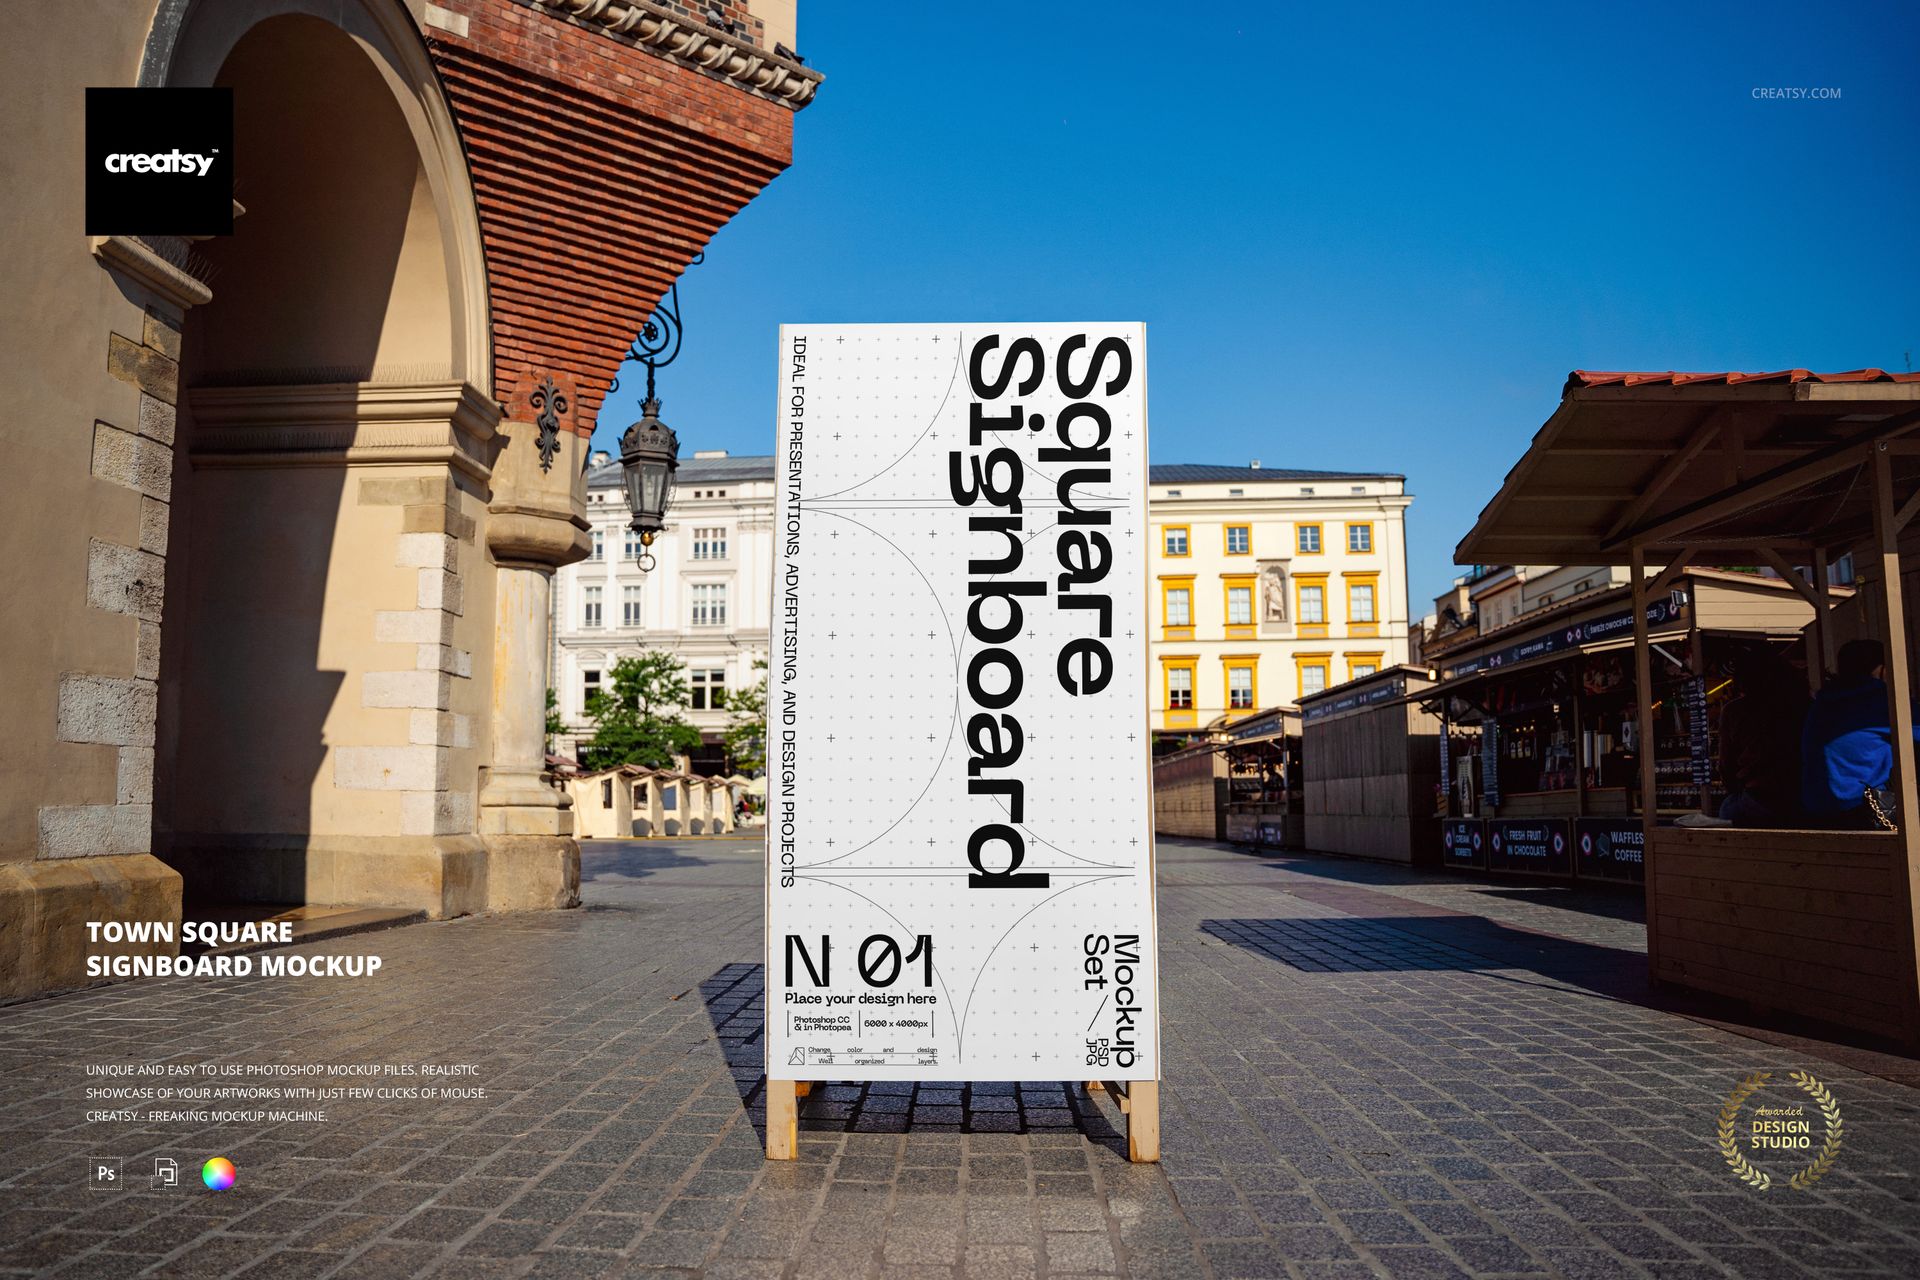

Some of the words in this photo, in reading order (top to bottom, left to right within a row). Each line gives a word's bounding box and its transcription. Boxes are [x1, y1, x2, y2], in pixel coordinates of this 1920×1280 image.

[792, 335, 807, 382] IDEAL
[791, 386, 805, 418] FOR
[784, 422, 804, 559] PRESENTATIONS,
[1038, 333, 1132, 697] Square
[781, 563, 798, 685] ADVERTISING,
[949, 334, 1050, 888] Signboard
[783, 690, 797, 725] AND
[782, 731, 796, 796] DESIGN
[781, 801, 795, 888] PROJECTS
[1507, 845, 1513, 855] IN
[1514, 845, 1547, 857] CHOCOLATE
[1509, 830, 1526, 840] FRESH
[1526, 830, 1542, 842] FRUIT
[1611, 831, 1644, 845] WAFFLES
[1614, 849, 1643, 863] COFFEE
[786, 935, 829, 987] N
[1084, 934, 1109, 990] Set
[785, 992, 822, 1004] Place
[826, 995, 856, 1007] your
[858, 992, 904, 1007] design
[907, 992, 937, 1004] here
[1110, 934, 1142, 1068] Mockup
[794, 1016, 836, 1024] Photoshop
[814, 1024, 852, 1033] Photopea
[808, 1046, 831, 1054] Change
[917, 1046, 938, 1054] design
[1086, 1038, 1097, 1066] JPG
[1098, 1038, 1109, 1067] PSD
